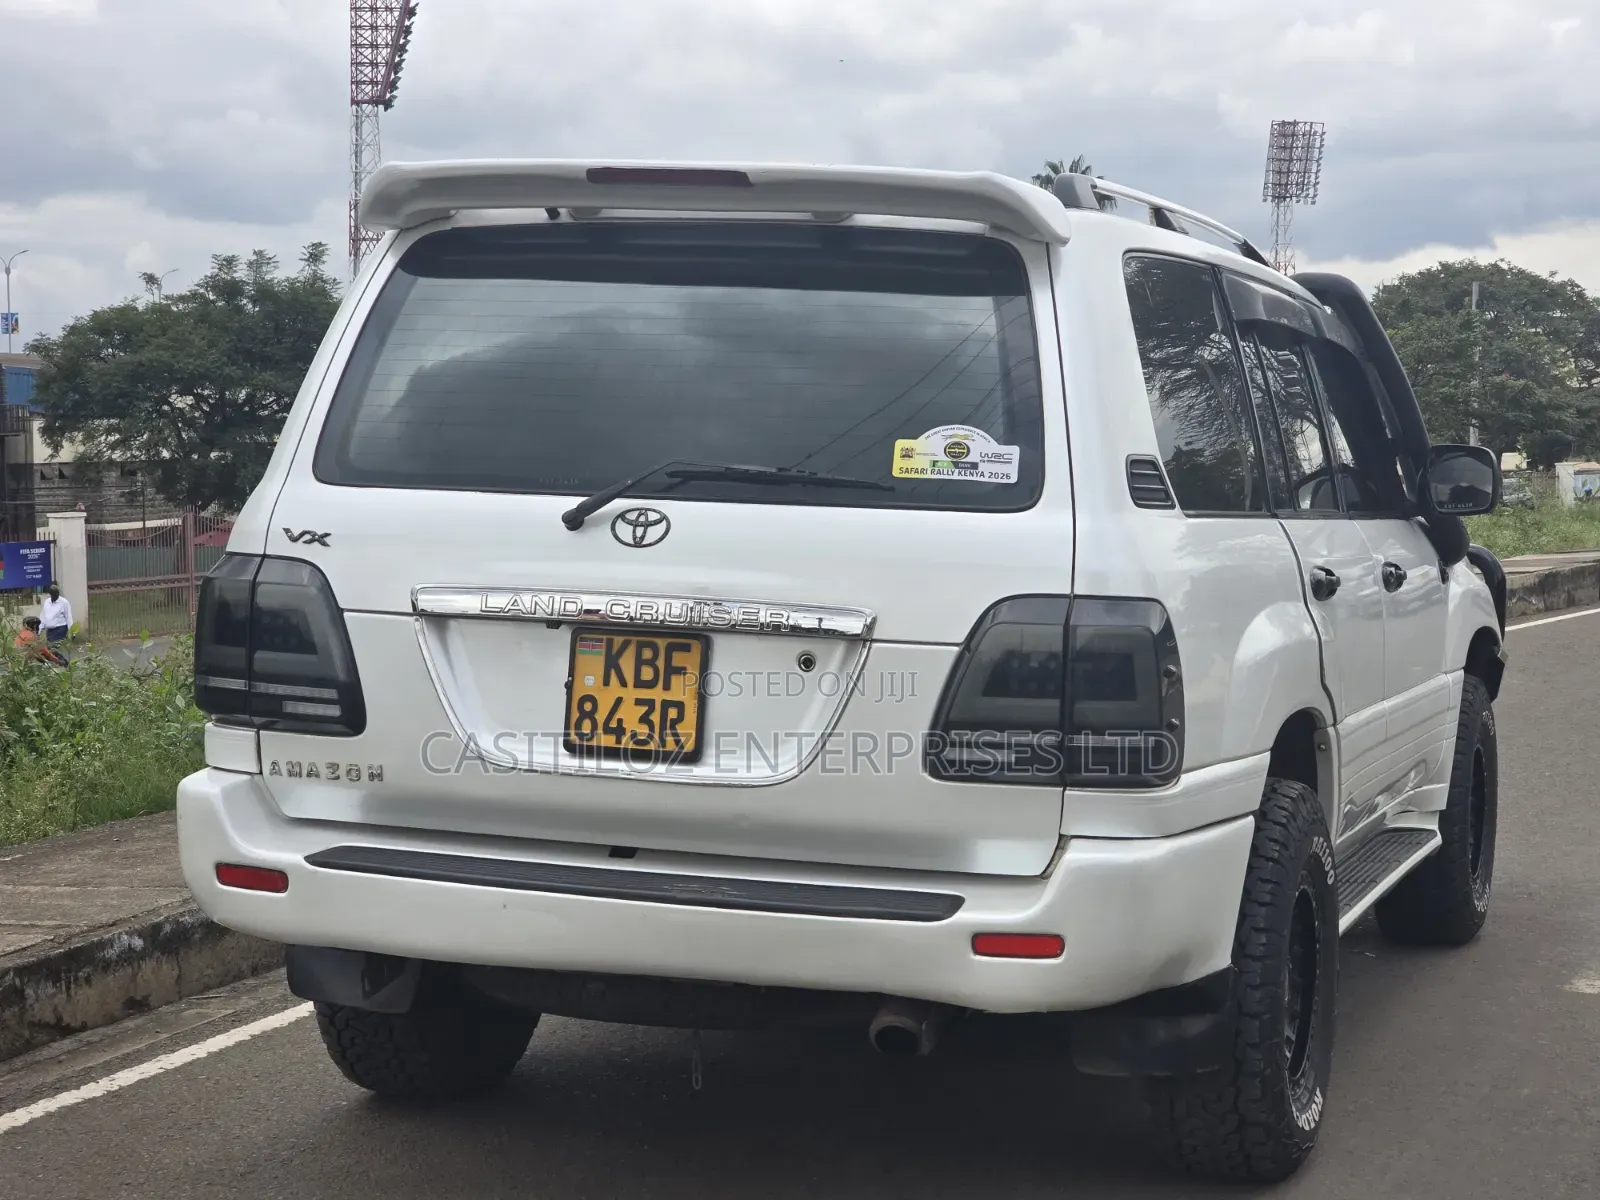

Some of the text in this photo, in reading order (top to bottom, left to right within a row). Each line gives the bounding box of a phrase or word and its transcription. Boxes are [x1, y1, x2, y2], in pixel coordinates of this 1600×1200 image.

[898, 467, 1012, 480] SAFARI RALLY KENYA 2026
[282, 527, 332, 547] VX
[480, 592, 791, 631] LAND CRUISER
[602, 637, 692, 691] KBF
[574, 693, 686, 750] 843R
